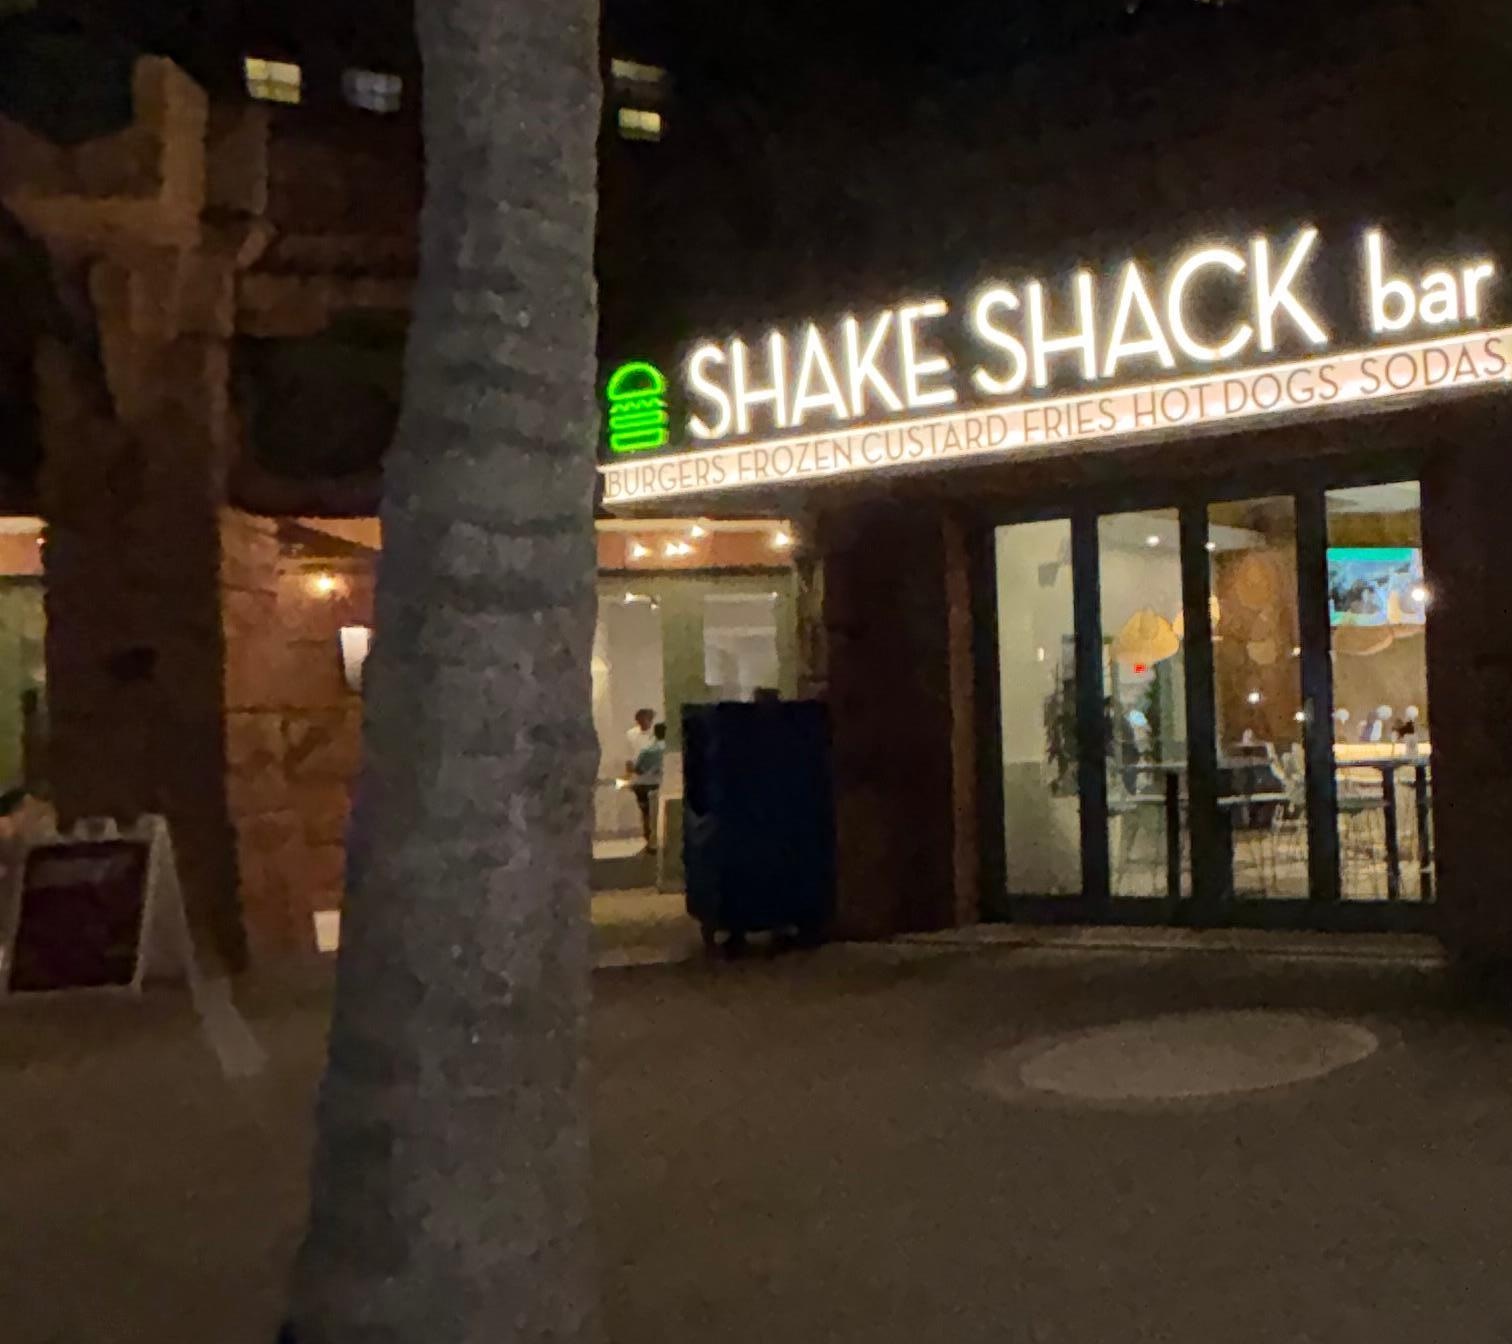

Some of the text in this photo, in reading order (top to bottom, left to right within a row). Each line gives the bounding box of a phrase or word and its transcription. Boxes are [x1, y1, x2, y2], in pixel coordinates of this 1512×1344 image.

[606, 338, 1507, 498] BURGERS FROZEN CUSTARD FRIES HOT DOGS SODAS
[686, 227, 1494, 438] SHAKE SHACK bar
